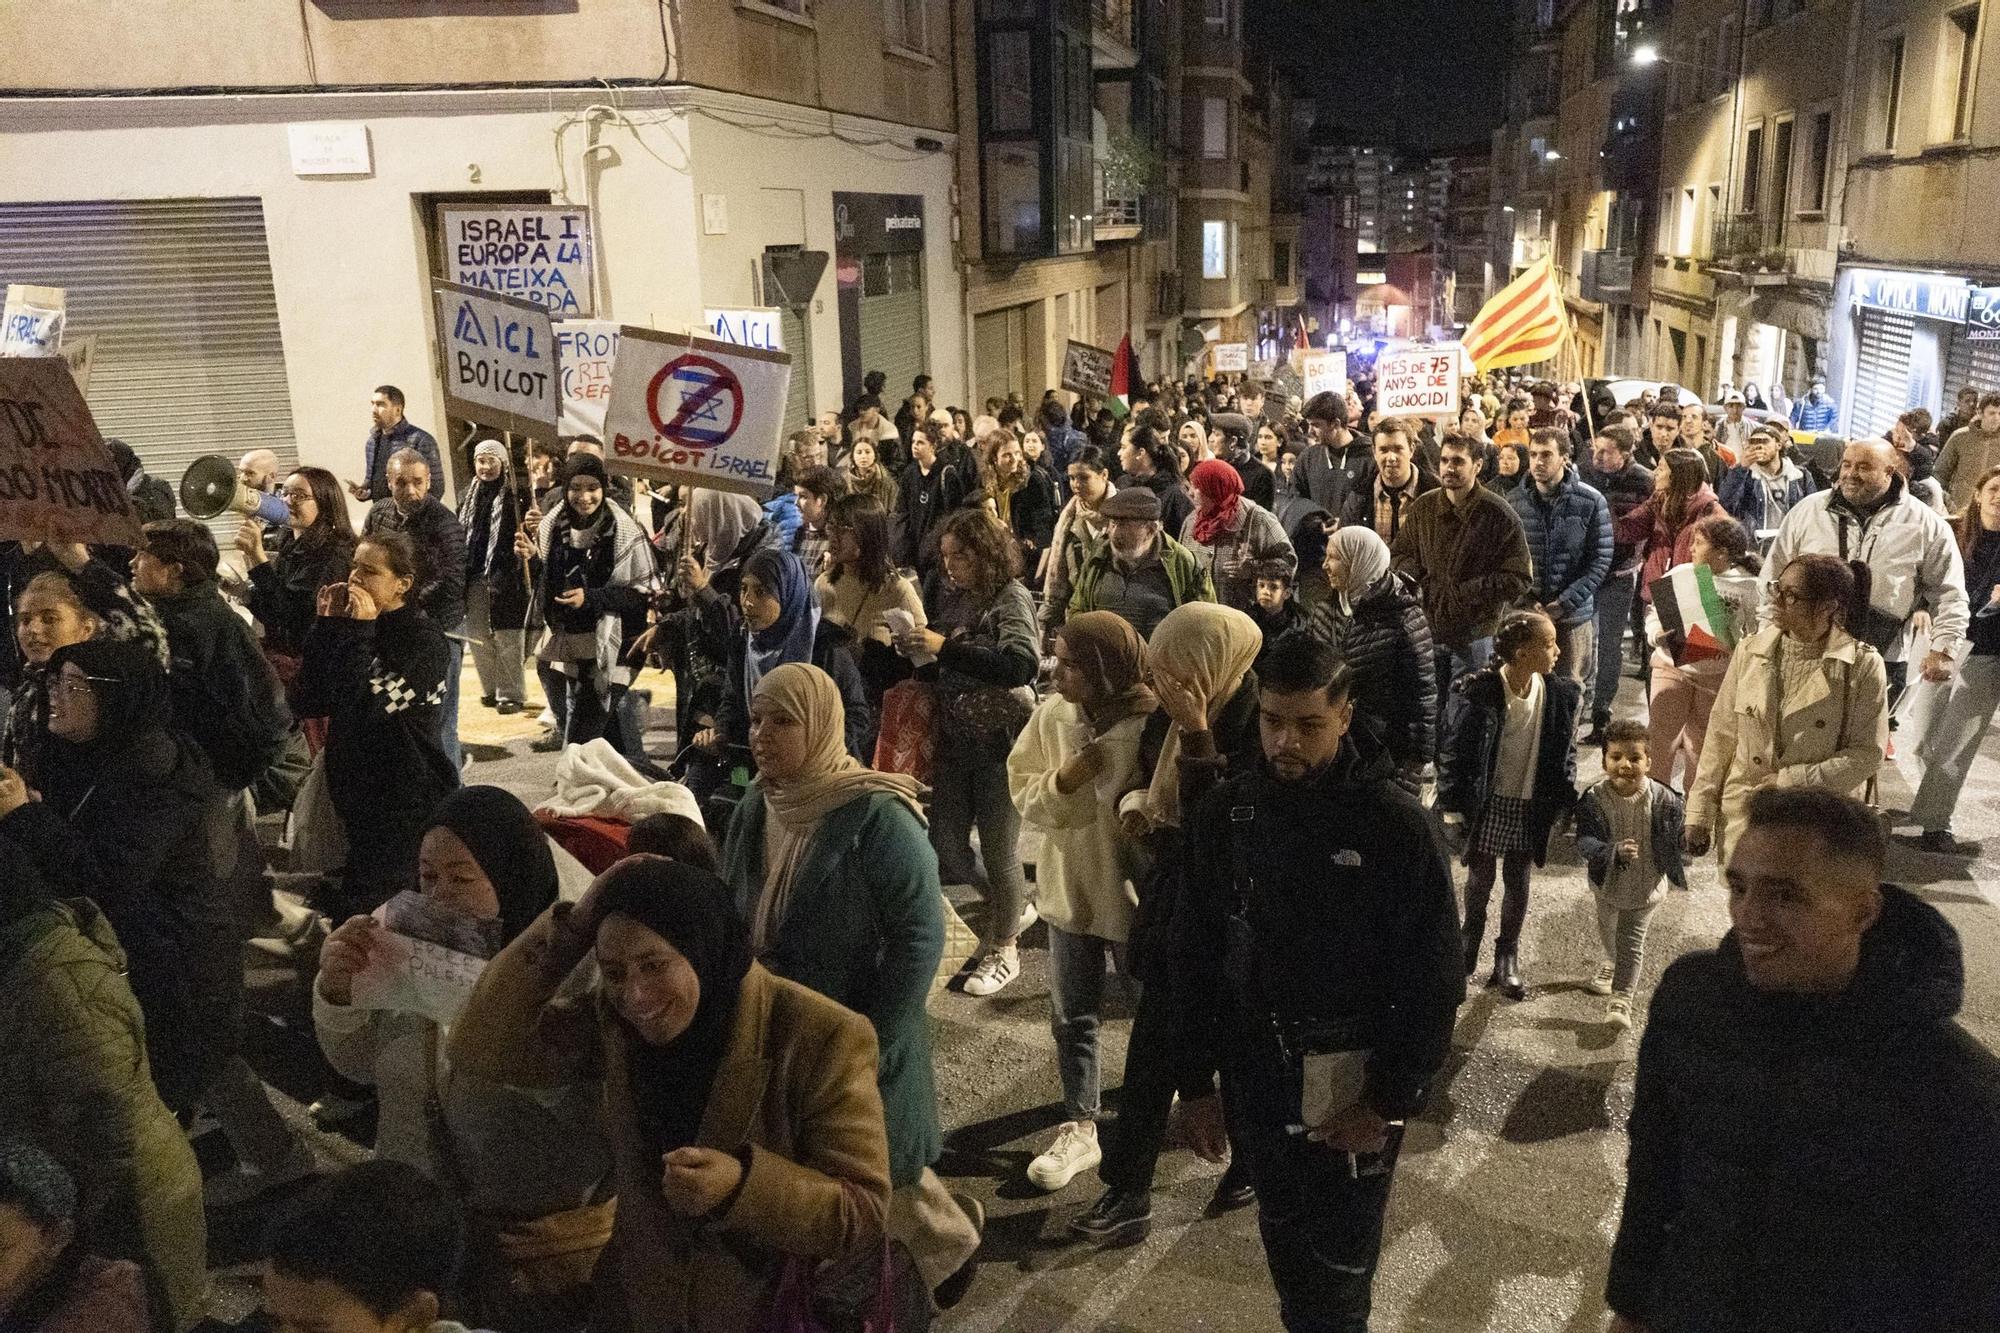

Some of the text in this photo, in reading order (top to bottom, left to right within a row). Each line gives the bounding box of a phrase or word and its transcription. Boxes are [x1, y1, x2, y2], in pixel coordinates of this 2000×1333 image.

[467, 163, 482, 184] 2
[461, 215, 580, 242] ISRAEL I
[458, 242, 583, 265] EUROPA LA
[459, 267, 568, 291] MATEIXA
[557, 331, 620, 358] FRO
[1411, 362, 1426, 374] DE
[1430, 356, 1449, 374] 75
[1384, 375, 1447, 391] ANYS DE
[1387, 391, 1449, 408] GENOCIDI
